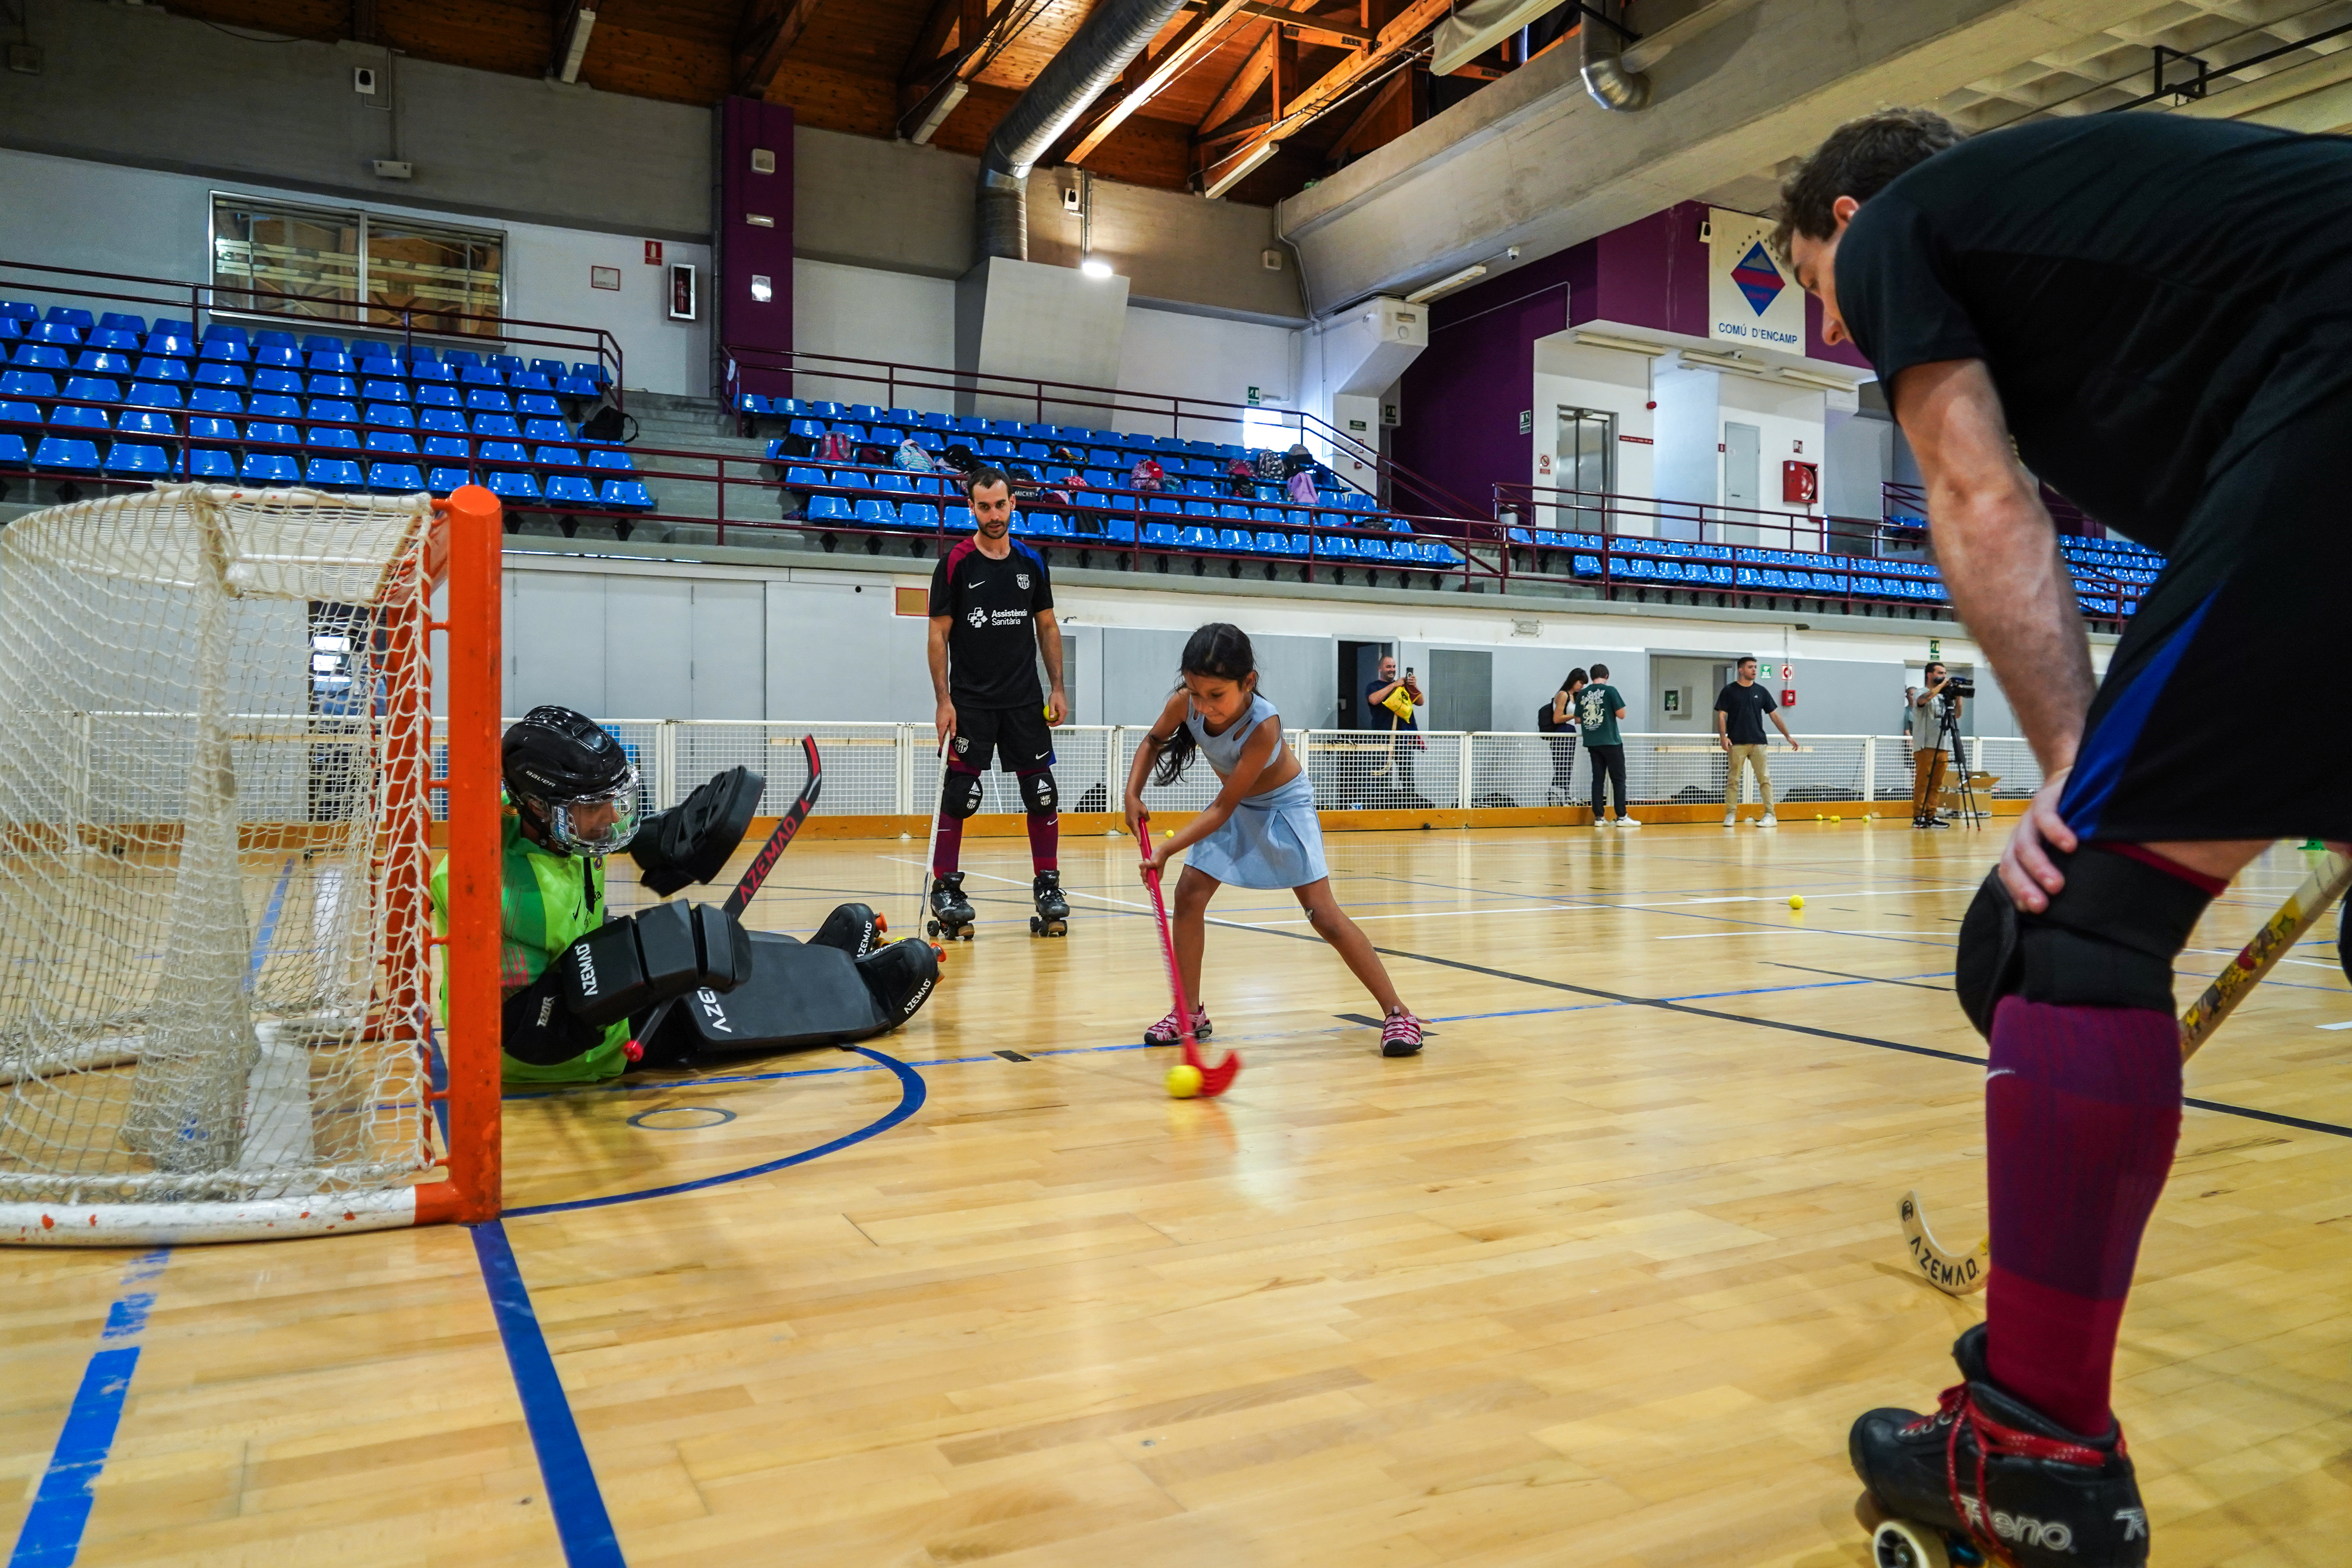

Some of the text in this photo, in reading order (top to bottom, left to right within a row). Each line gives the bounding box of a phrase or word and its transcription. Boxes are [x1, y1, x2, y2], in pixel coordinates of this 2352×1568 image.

[1719, 323, 1797, 344] COMÚ D'ENCAMP
[991, 609, 1028, 618] Assistència
[992, 617, 1021, 626] Sanitària
[739, 816, 797, 906] AZEMAD
[575, 942, 599, 996] AZEMAD
[697, 986, 732, 1033] AZE
[904, 978, 931, 1015] AZEMAD
[1910, 1236, 1981, 1286] AZEMAD
